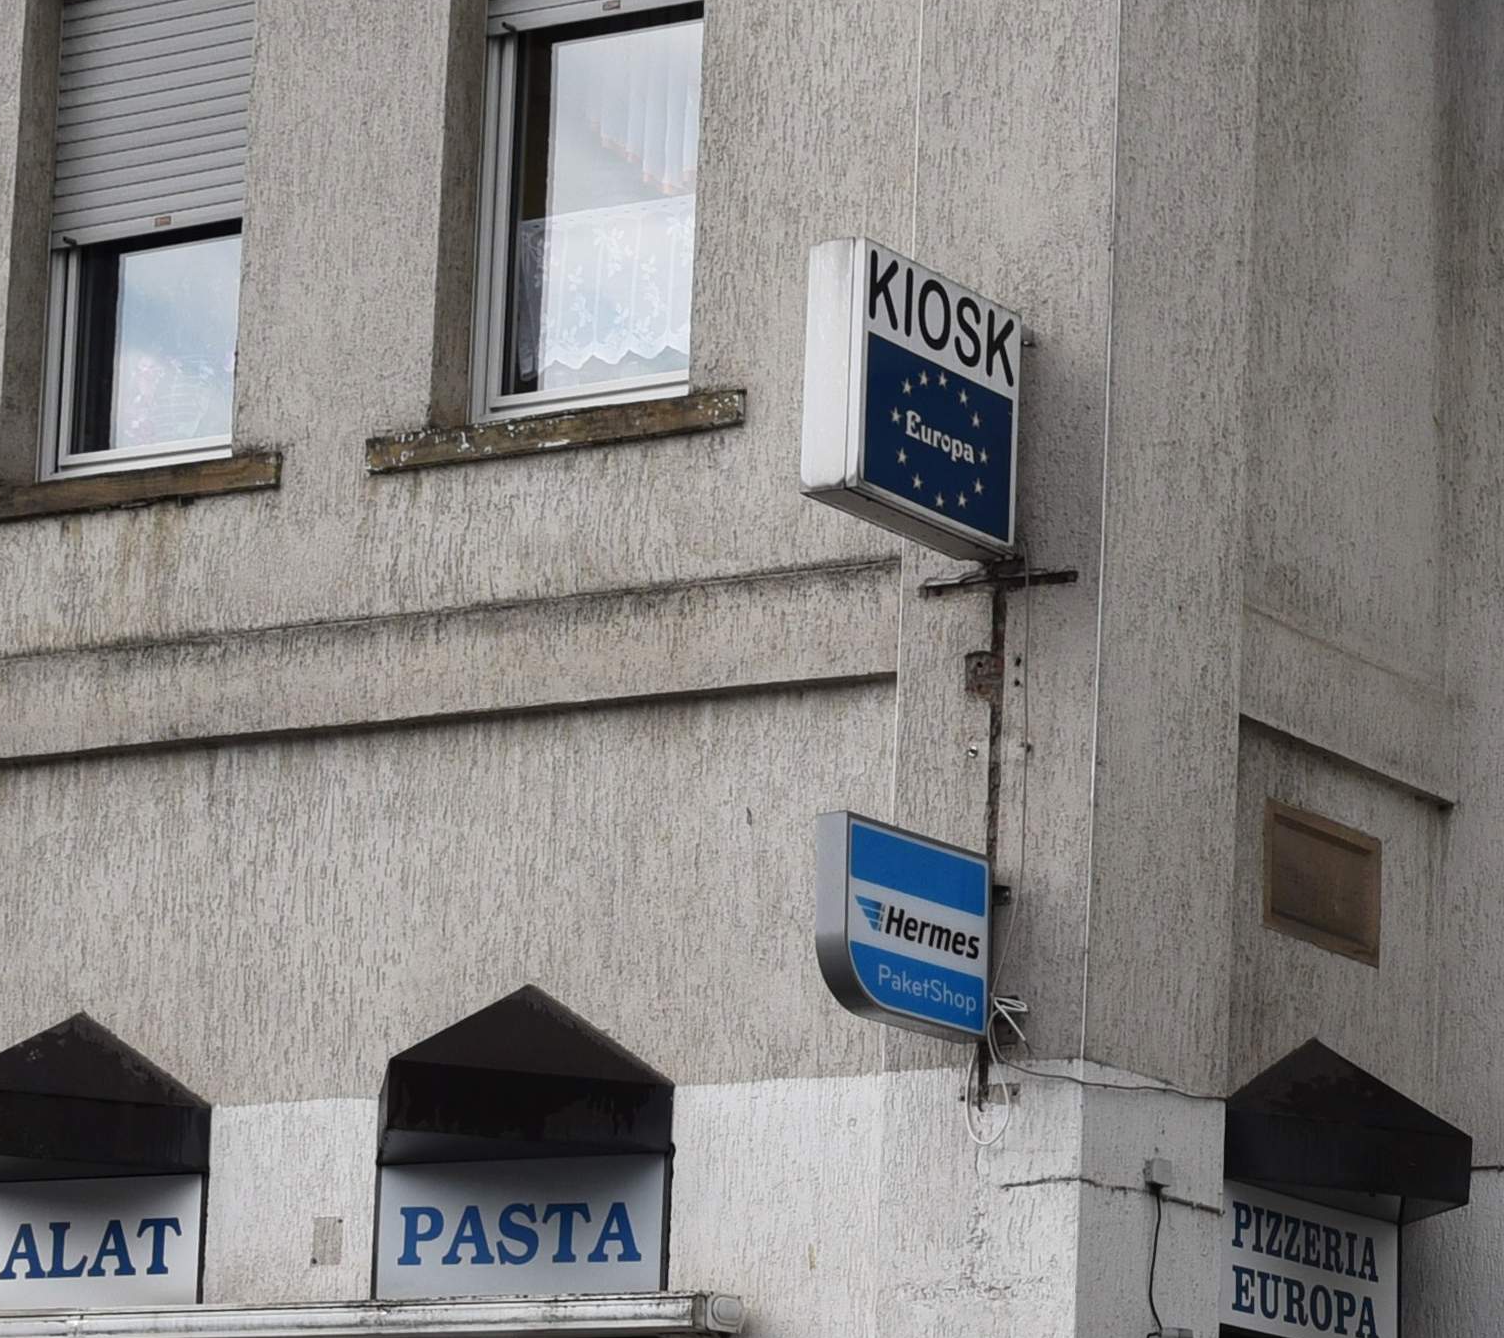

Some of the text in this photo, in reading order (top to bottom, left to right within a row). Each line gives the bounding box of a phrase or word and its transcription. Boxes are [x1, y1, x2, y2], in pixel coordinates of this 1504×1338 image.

[868, 249, 1014, 388] KIOSK
[905, 409, 976, 465] Europa
[884, 905, 981, 961] Hermes
[877, 963, 978, 1015] PaketShop
[397, 1201, 642, 1267] PASTA
[1231, 1200, 1379, 1284] PIZZERIA
